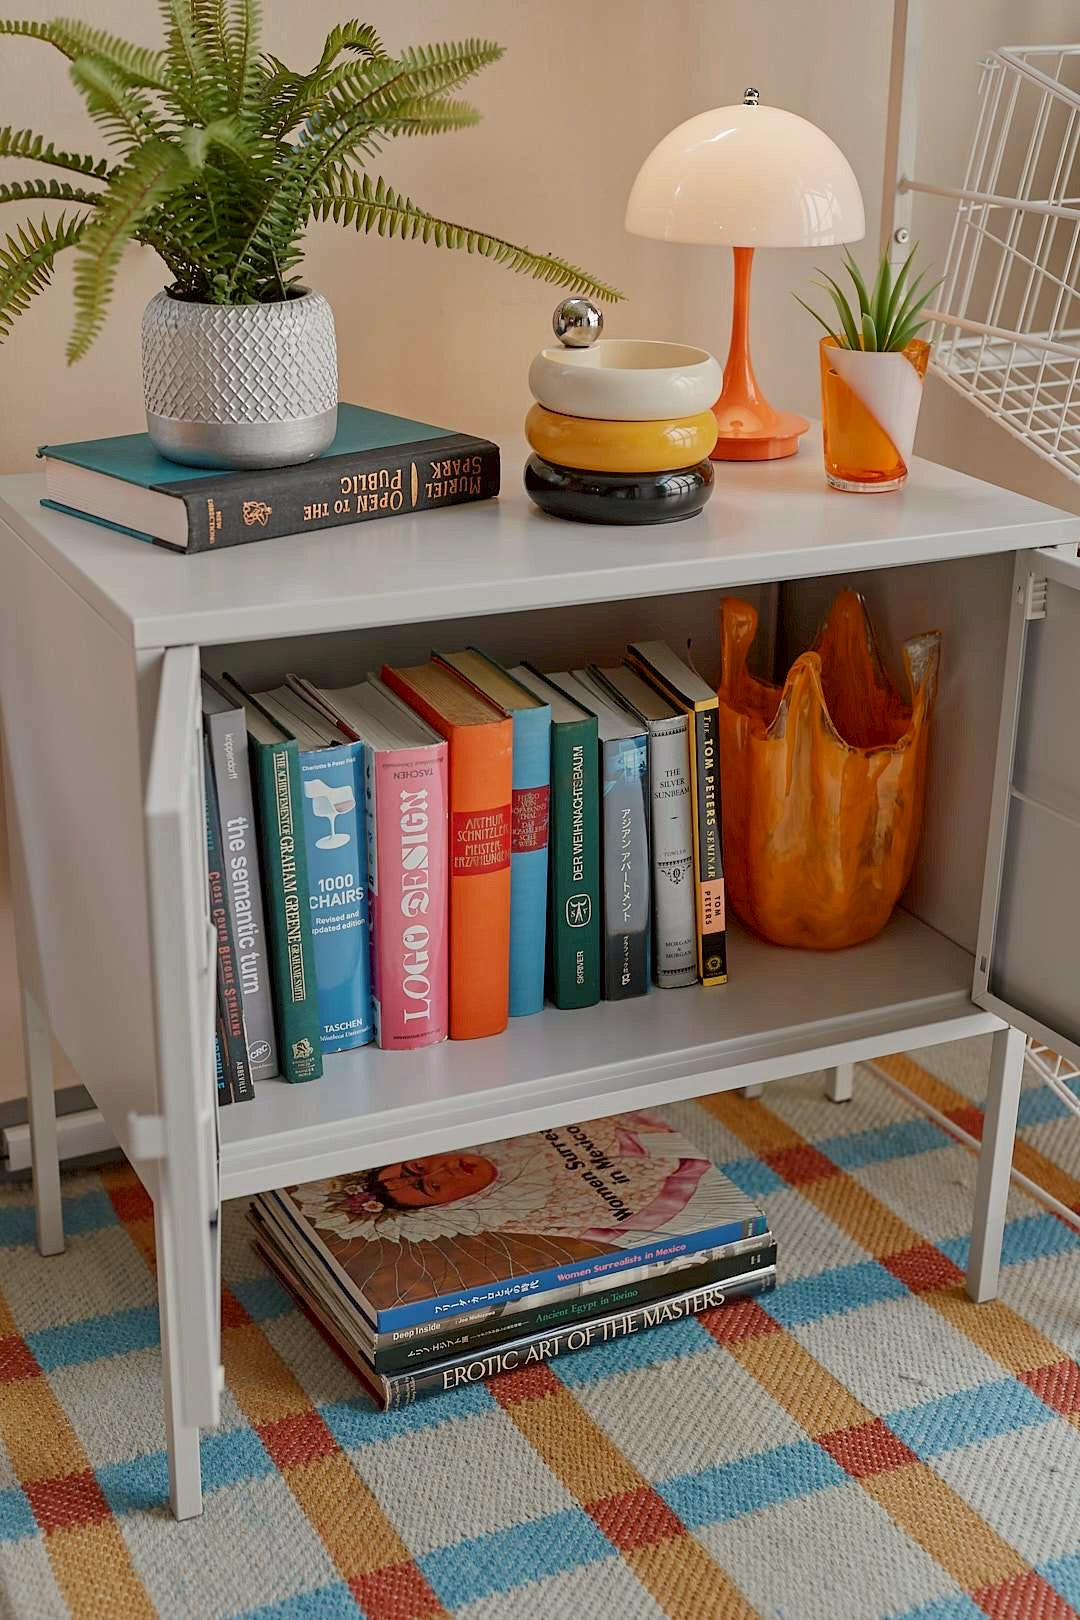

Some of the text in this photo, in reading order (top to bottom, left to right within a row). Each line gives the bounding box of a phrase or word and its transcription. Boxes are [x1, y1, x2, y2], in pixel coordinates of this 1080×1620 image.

[340, 469, 402, 496] PUBLIC
[425, 456, 481, 499] MURIEL SPARK
[303, 490, 403, 521] OPEN TO THE
[223, 732, 238, 779] krippendorff
[275, 751, 286, 769] THE
[393, 768, 434, 780] TASCHEN
[659, 777, 685, 789] SILVER
[664, 768, 681, 778] THE
[276, 769, 290, 824] ACHIEVEMENT
[654, 786, 690, 800] SUNBEAM
[703, 715, 717, 879] THE TOM PETERS SEMINAR
[466, 812, 504, 830] ARTHUR
[572, 745, 584, 881] DER WEIHNACHTSBAUM
[280, 824, 291, 836] OF
[457, 824, 509, 842] SCHNITZLER
[280, 835, 297, 892] GRAHAM
[400, 789, 430, 917] DESIGN
[309, 887, 364, 909] CHAIRS
[318, 873, 354, 892] 1000
[227, 816, 261, 995] the semantic turn
[285, 894, 302, 943] GREENE
[316, 910, 360, 925] Revised and
[704, 890, 712, 925] PETERS
[341, 918, 366, 930] edition
[209, 871, 242, 1038] CLOSE COVER BEFORE STRIKING
[665, 939, 692, 948] MORGAN
[665, 951, 692, 959] MORGAN
[402, 925, 432, 1024] LOGO
[576, 950, 585, 984] SKRIVER
[324, 1018, 363, 1033] TASCHEN
[250, 1044, 268, 1059] CRC
[235, 1061, 247, 1093] ABBEVILLE
[567, 1126, 630, 1185] in Mexico
[582, 1171, 634, 1222] Women
[556, 1243, 687, 1282] Women Surrealists in Mexico
[535, 1287, 638, 1323] Ancient Egypt in Torino
[393, 1329, 415, 1341] Deep
[415, 1322, 441, 1336] Inside
[442, 1287, 726, 1390] EROTIC ART OF THE MASTERS
